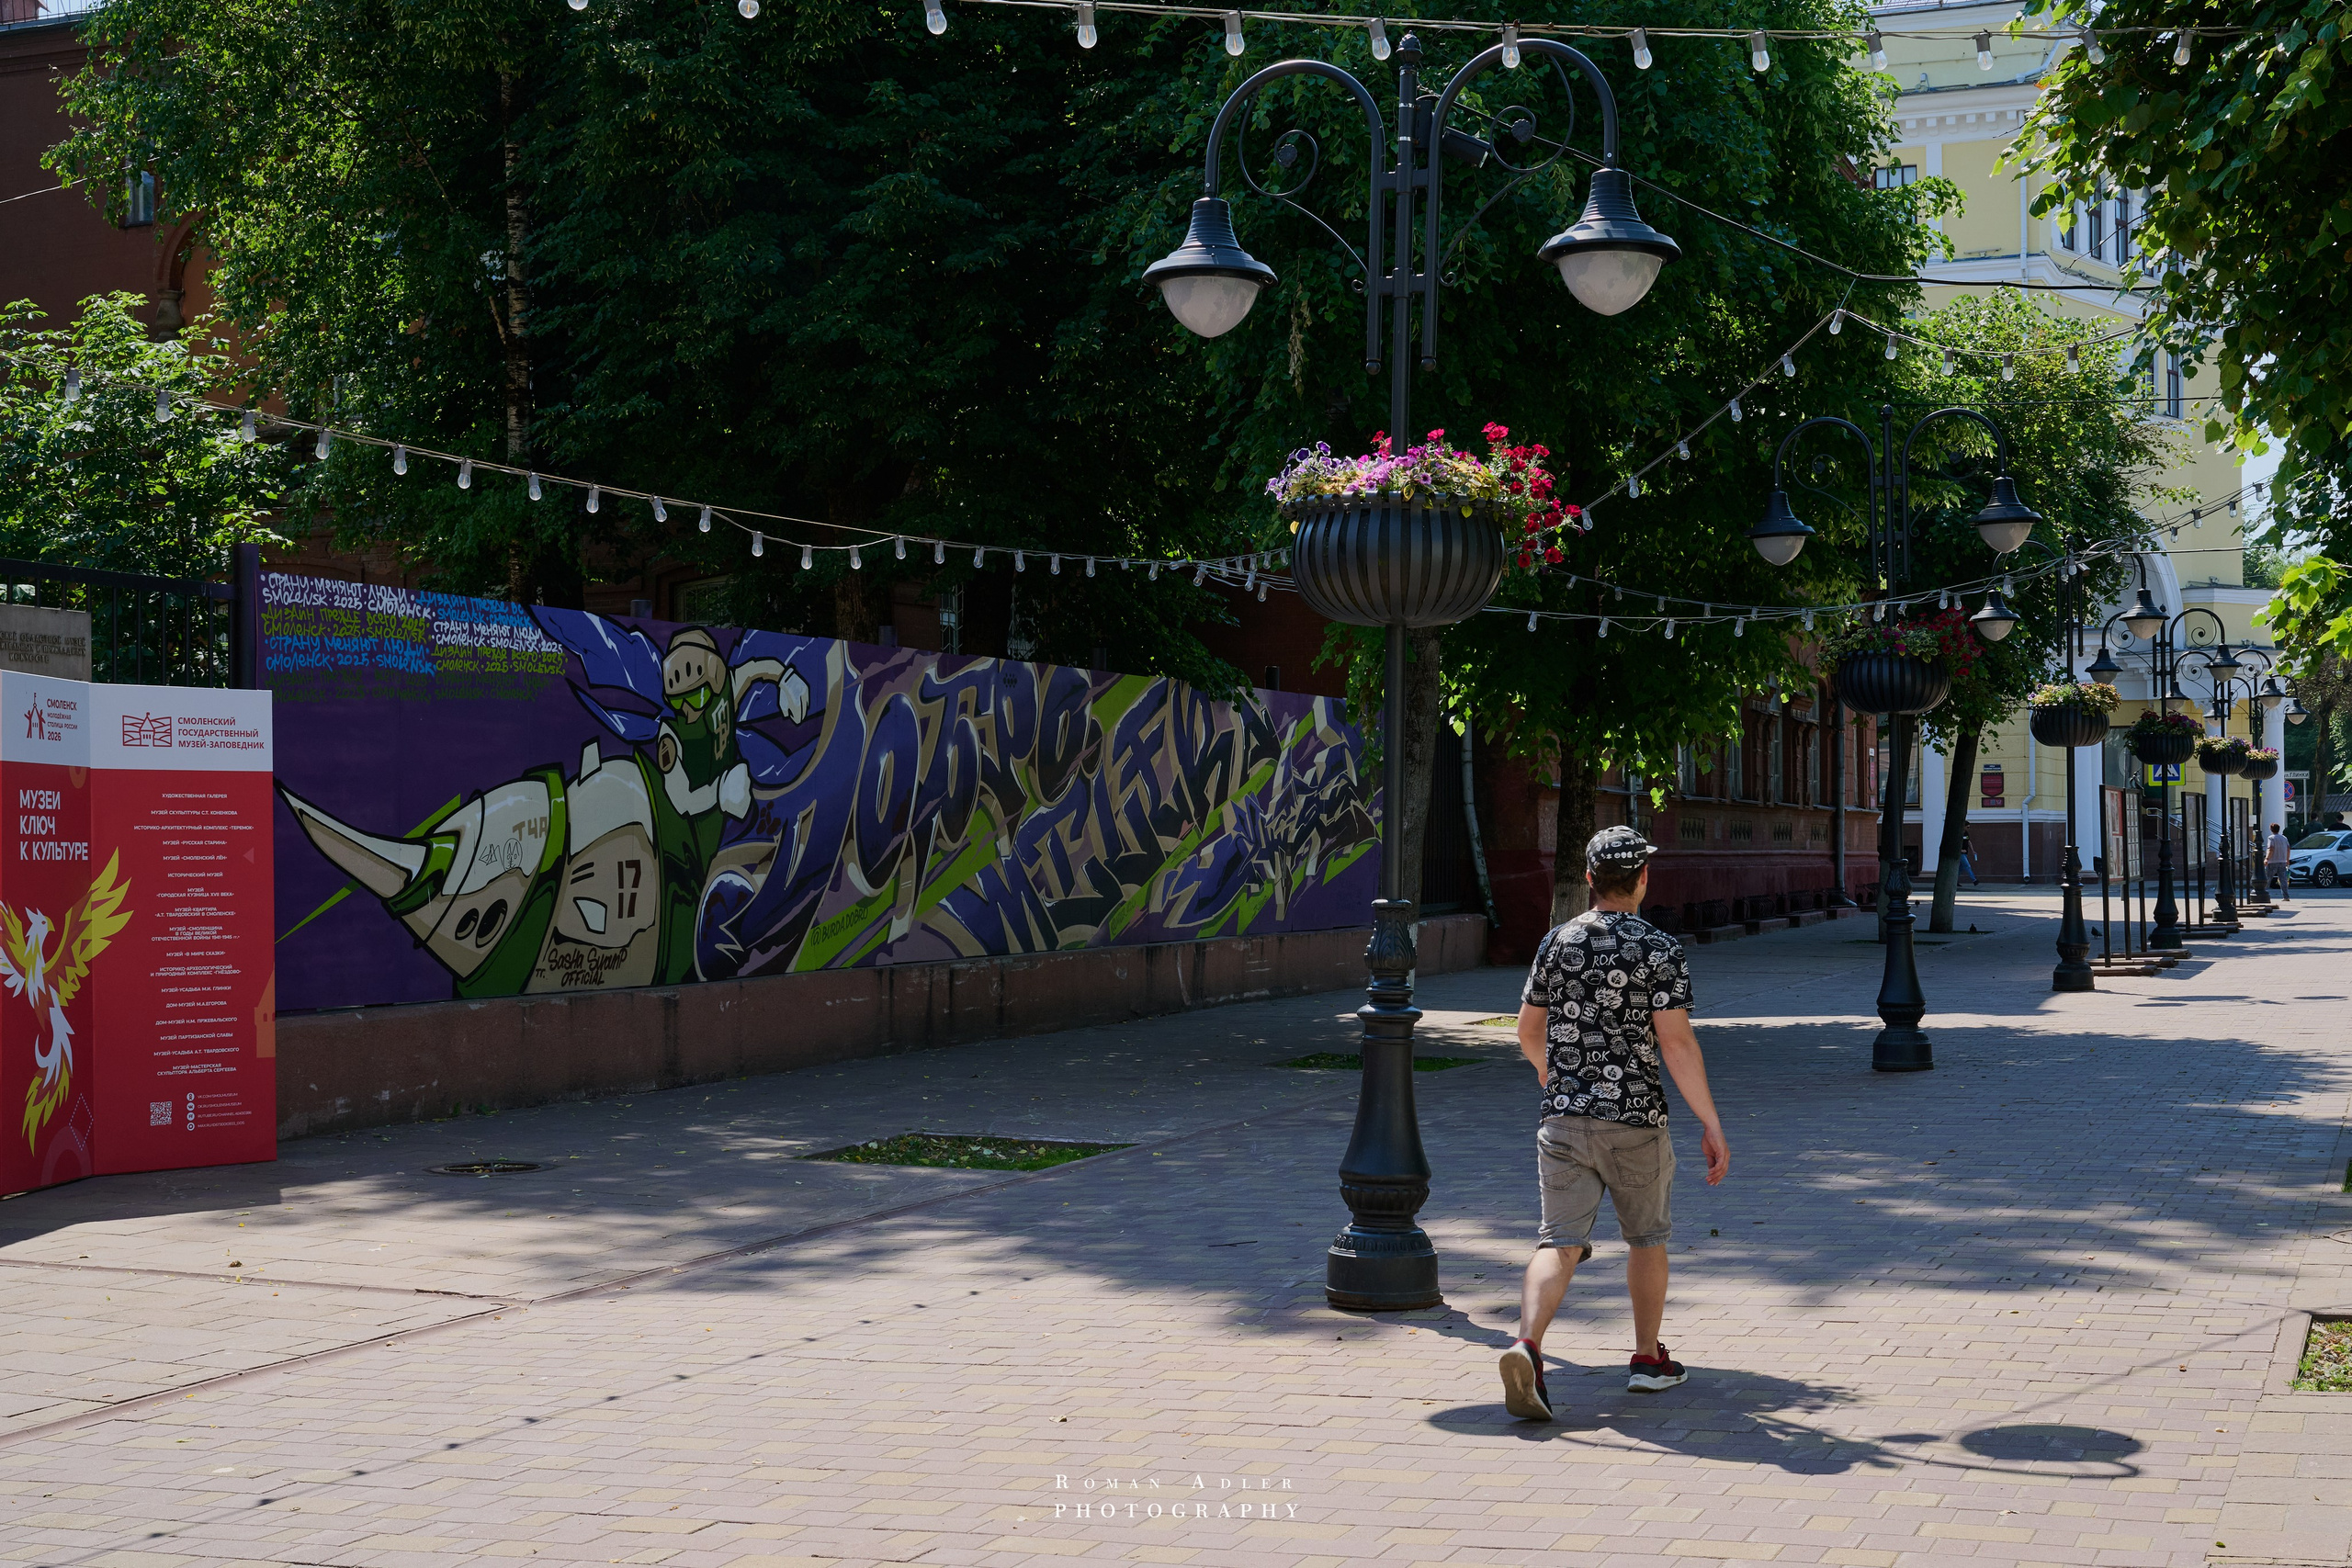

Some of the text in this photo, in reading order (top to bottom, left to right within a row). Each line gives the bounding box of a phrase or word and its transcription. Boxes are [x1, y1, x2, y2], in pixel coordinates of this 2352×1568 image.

[334, 596, 363, 610] 2025
[401, 615, 425, 632] 2025
[333, 625, 361, 638] 2025
[19, 632, 62, 645] ОБЛАСТНОЙ
[269, 635, 320, 653] СТРАНУ
[383, 637, 425, 659] ЛЮДИ
[540, 639, 563, 654] 2025
[336, 652, 369, 666] 2025
[484, 661, 508, 673] 2025
[47, 698, 77, 711] СМОЛЕНСК
[178, 716, 235, 727] СМОЛЕНСКИЙ
[48, 731, 62, 741] 2026
[178, 728, 258, 738] ГОСУДАРСТВЕННЫЙ
[178, 739, 265, 750] МУЗЕЙ-ЗАПОВЕДНИК
[19, 789, 61, 810] МУЗЕИ
[20, 815, 55, 835] КЛЮЧ
[20, 841, 88, 861] К КУЛЬТУРЕ
